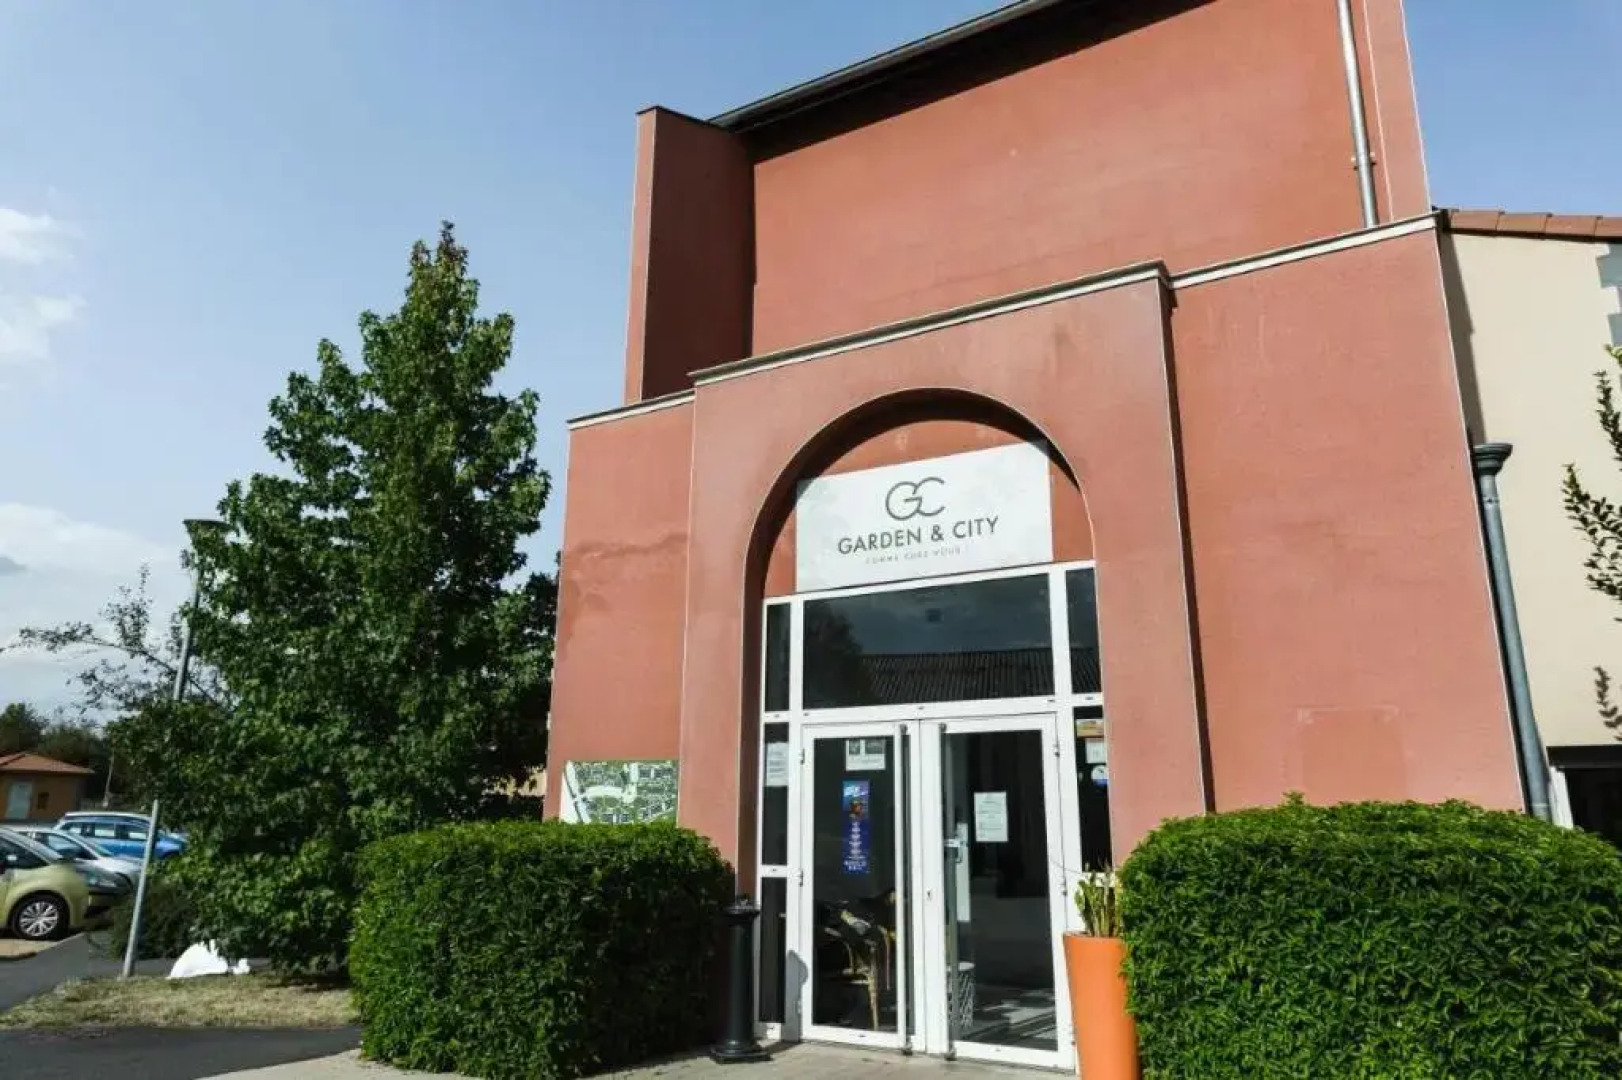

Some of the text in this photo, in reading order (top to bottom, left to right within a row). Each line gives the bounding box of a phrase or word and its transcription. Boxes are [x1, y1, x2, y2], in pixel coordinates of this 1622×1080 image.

[885, 476, 946, 521] GC
[837, 516, 999, 555] GARDEN & CITY
